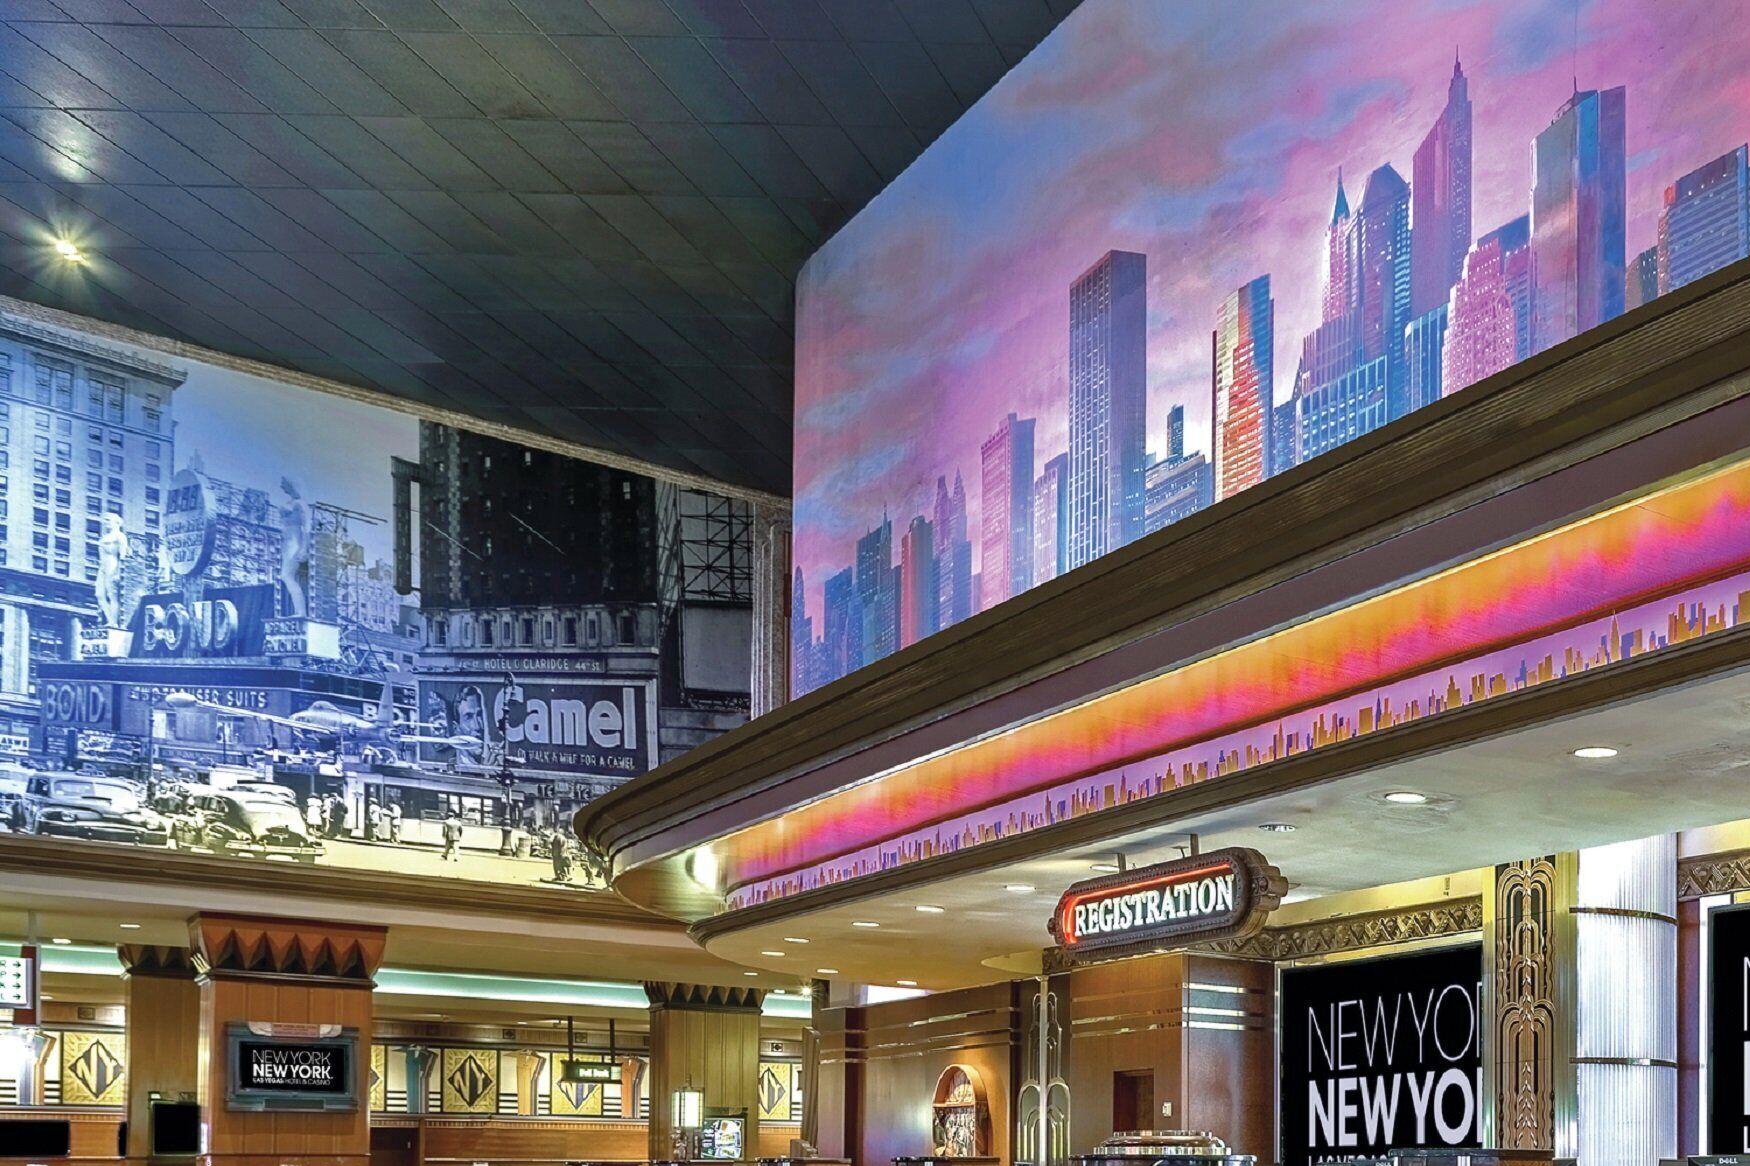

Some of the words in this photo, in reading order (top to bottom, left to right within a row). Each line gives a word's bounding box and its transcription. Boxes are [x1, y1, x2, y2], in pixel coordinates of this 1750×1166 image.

[46, 685, 104, 723] BOND
[227, 691, 267, 708] SUITS
[494, 685, 637, 750] Camel
[1074, 874, 1235, 937] REGISTRATION
[1308, 993, 1401, 1073] NEW
[1407, 981, 1483, 1064] YO
[252, 1049, 288, 1064] NEW
[290, 1050, 331, 1065] YORK
[253, 1064, 288, 1078] NEW
[1308, 1073, 1401, 1148] NEW
[1407, 1067, 1483, 1145] YO
